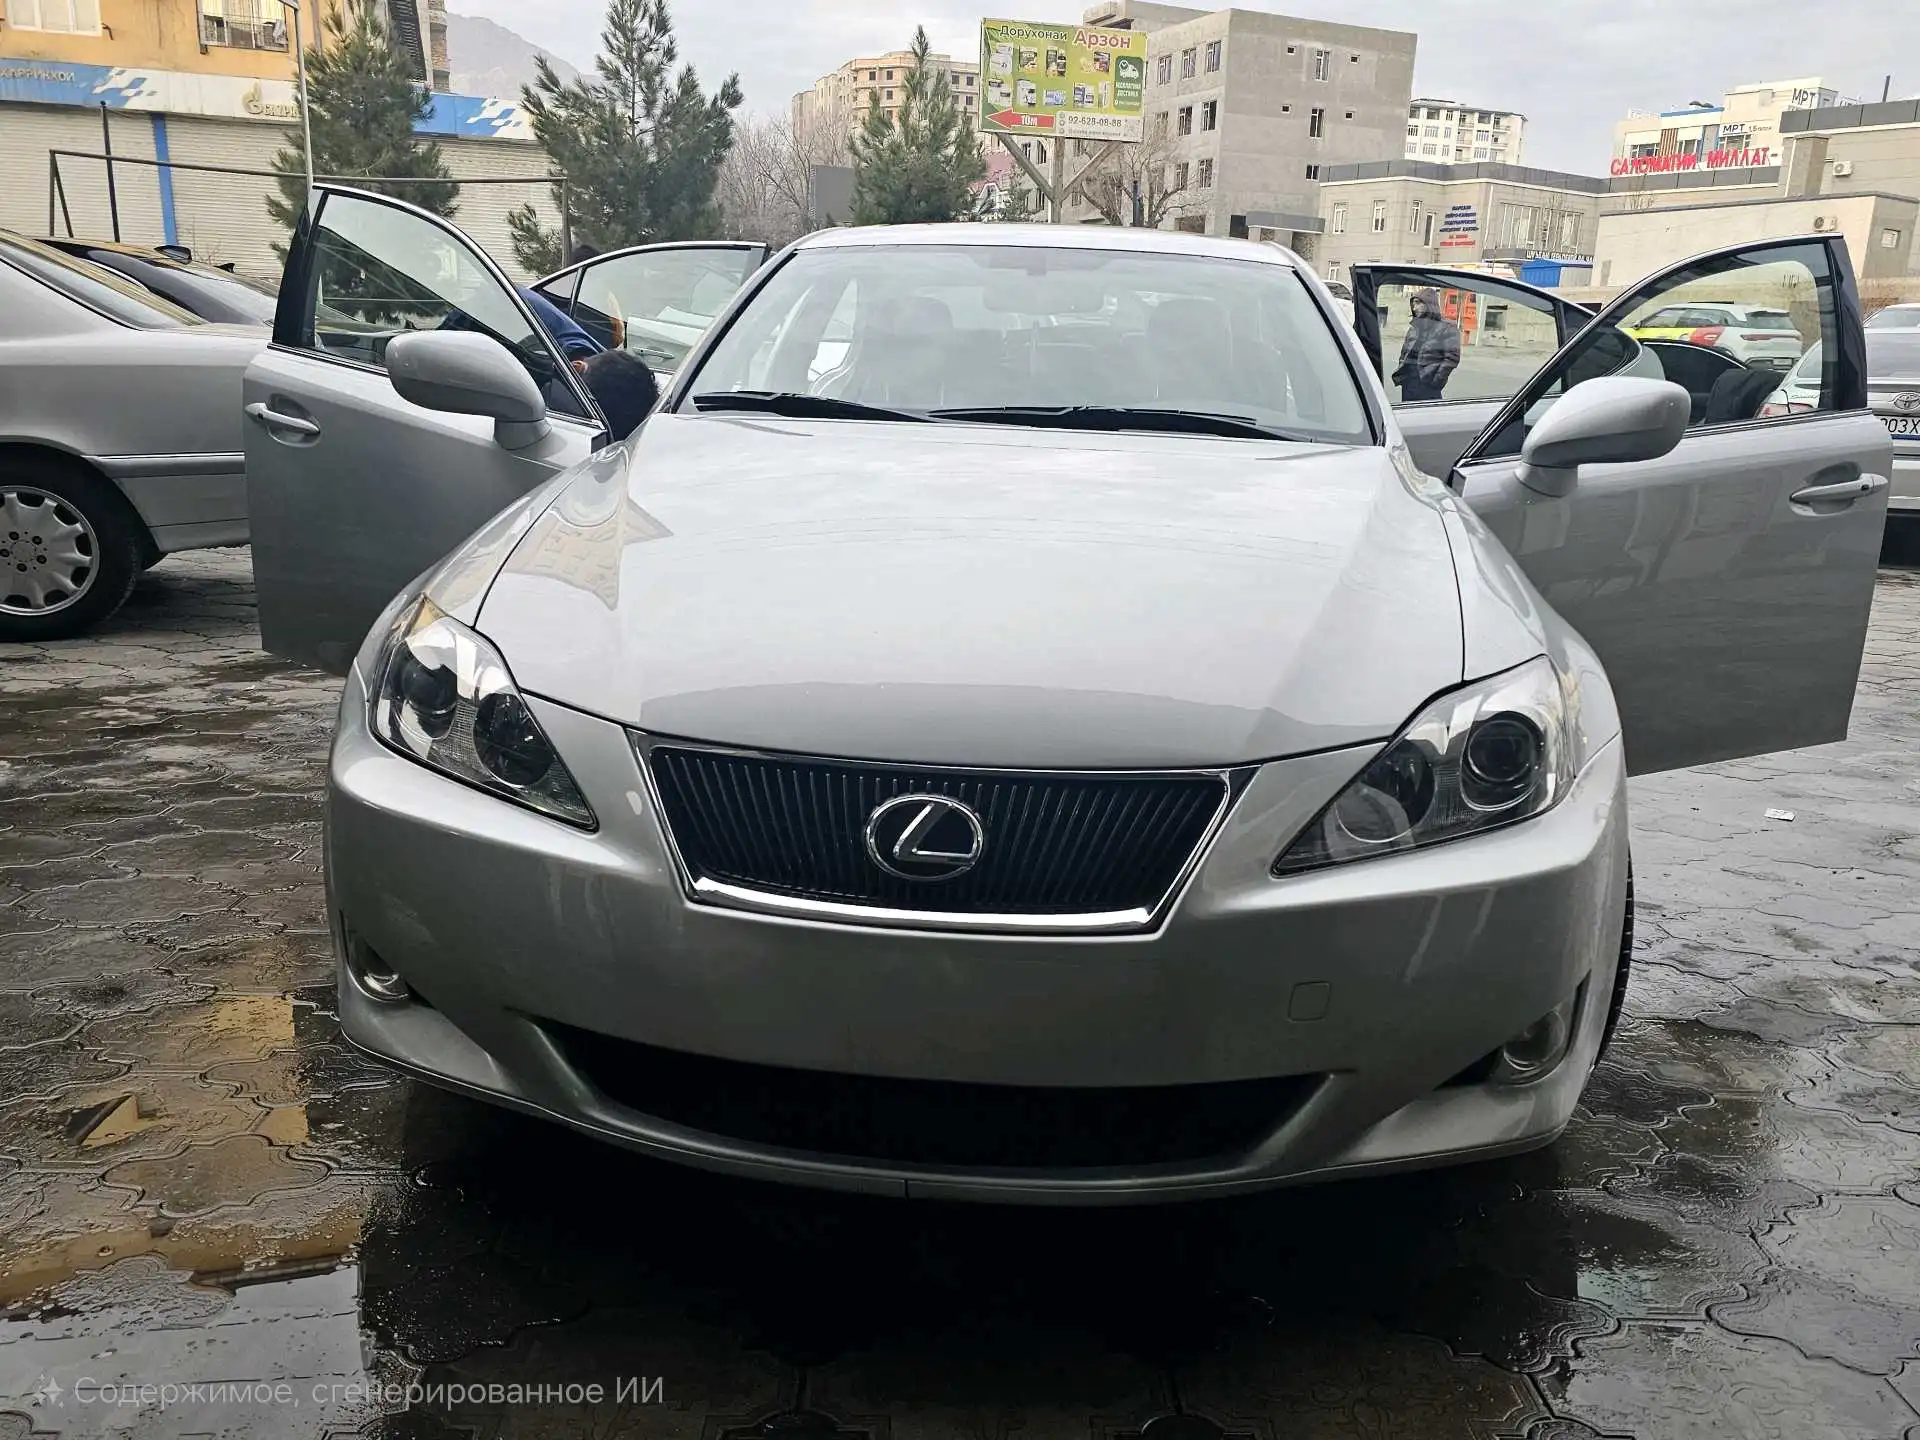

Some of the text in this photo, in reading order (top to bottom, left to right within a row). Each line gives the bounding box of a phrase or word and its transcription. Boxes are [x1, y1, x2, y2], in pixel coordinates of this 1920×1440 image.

[999, 25, 1131, 49] Дорухонаи Арзон
[1791, 87, 1816, 108] МРТ
[1722, 123, 1746, 133] МРТ
[1707, 146, 1770, 169] МИЛЛАТ
